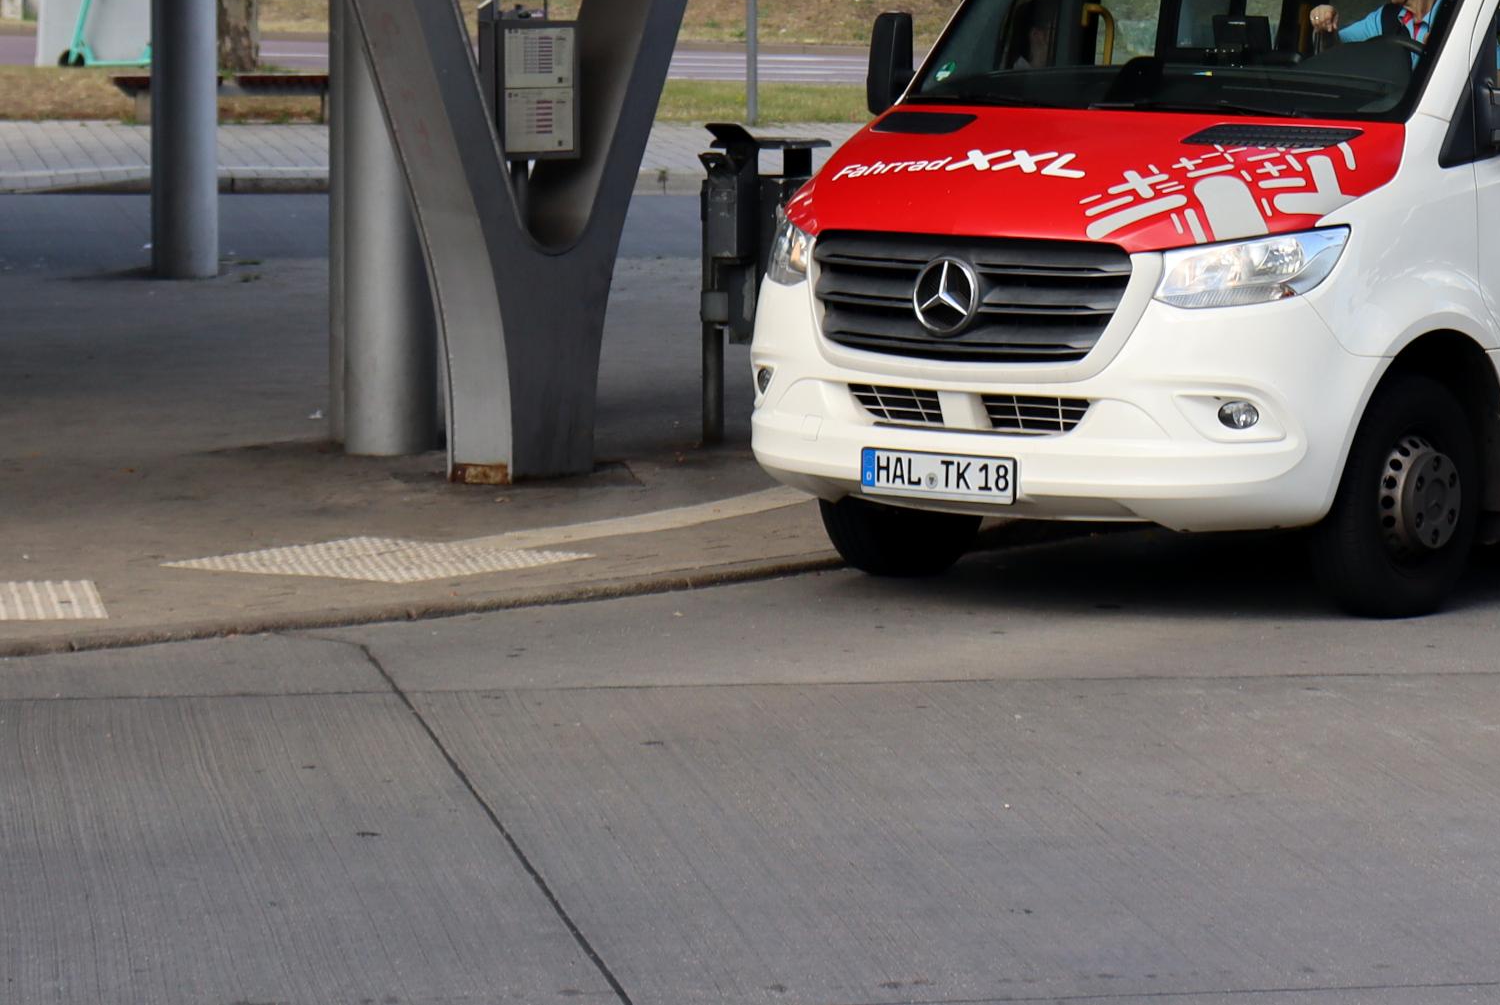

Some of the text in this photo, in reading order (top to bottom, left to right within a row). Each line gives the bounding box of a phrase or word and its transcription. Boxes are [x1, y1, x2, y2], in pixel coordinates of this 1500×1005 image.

[832, 149, 1086, 182] Fahrrad XXL
[876, 455, 922, 486] HAL
[941, 460, 971, 490] TK
[978, 463, 1009, 492] 18
